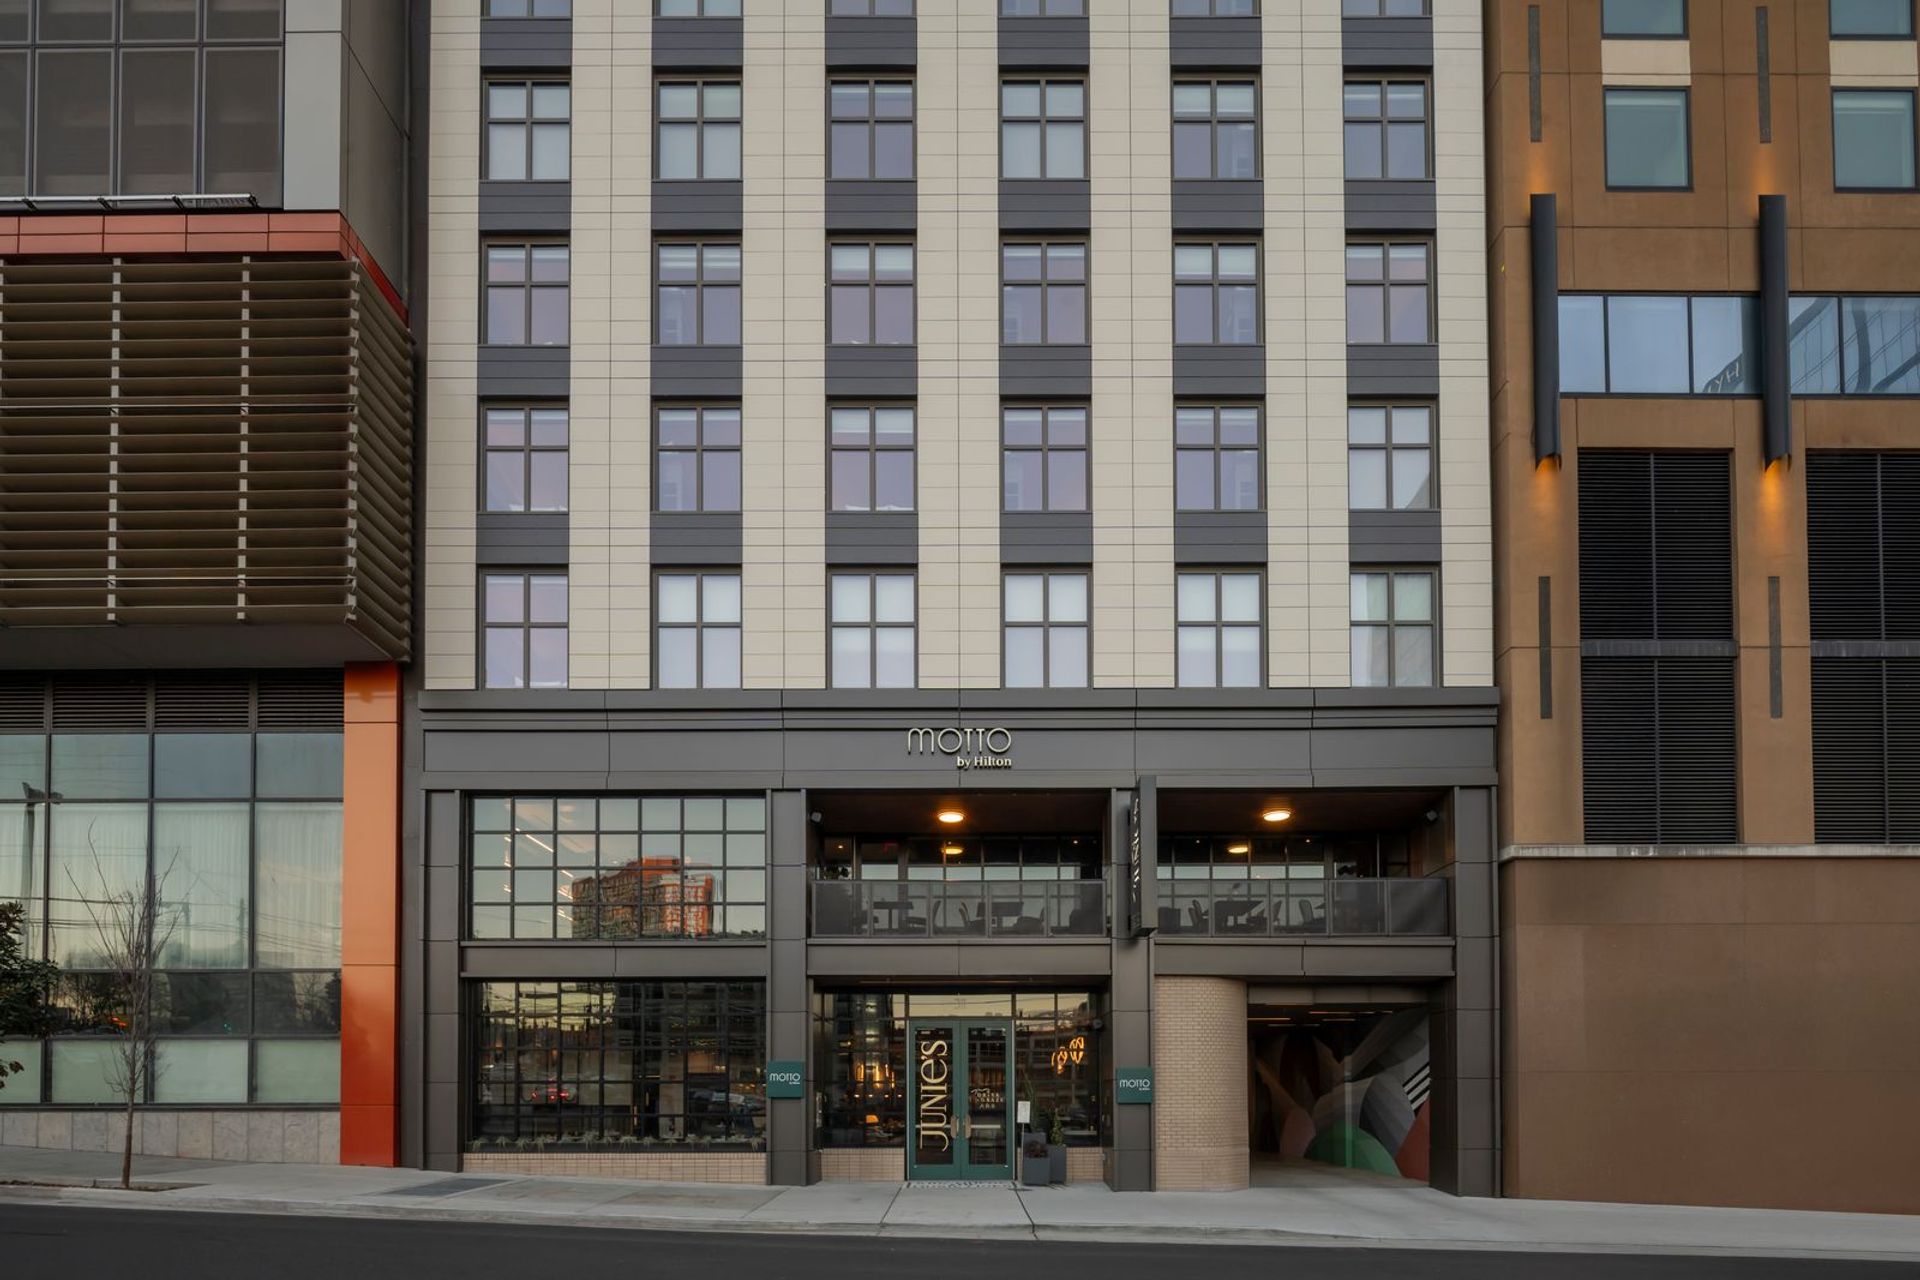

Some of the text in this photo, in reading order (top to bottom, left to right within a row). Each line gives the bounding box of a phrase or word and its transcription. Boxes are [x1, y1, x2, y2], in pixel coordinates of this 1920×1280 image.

[907, 727, 1012, 753] MOTTO
[956, 756, 1012, 769] by Hilton
